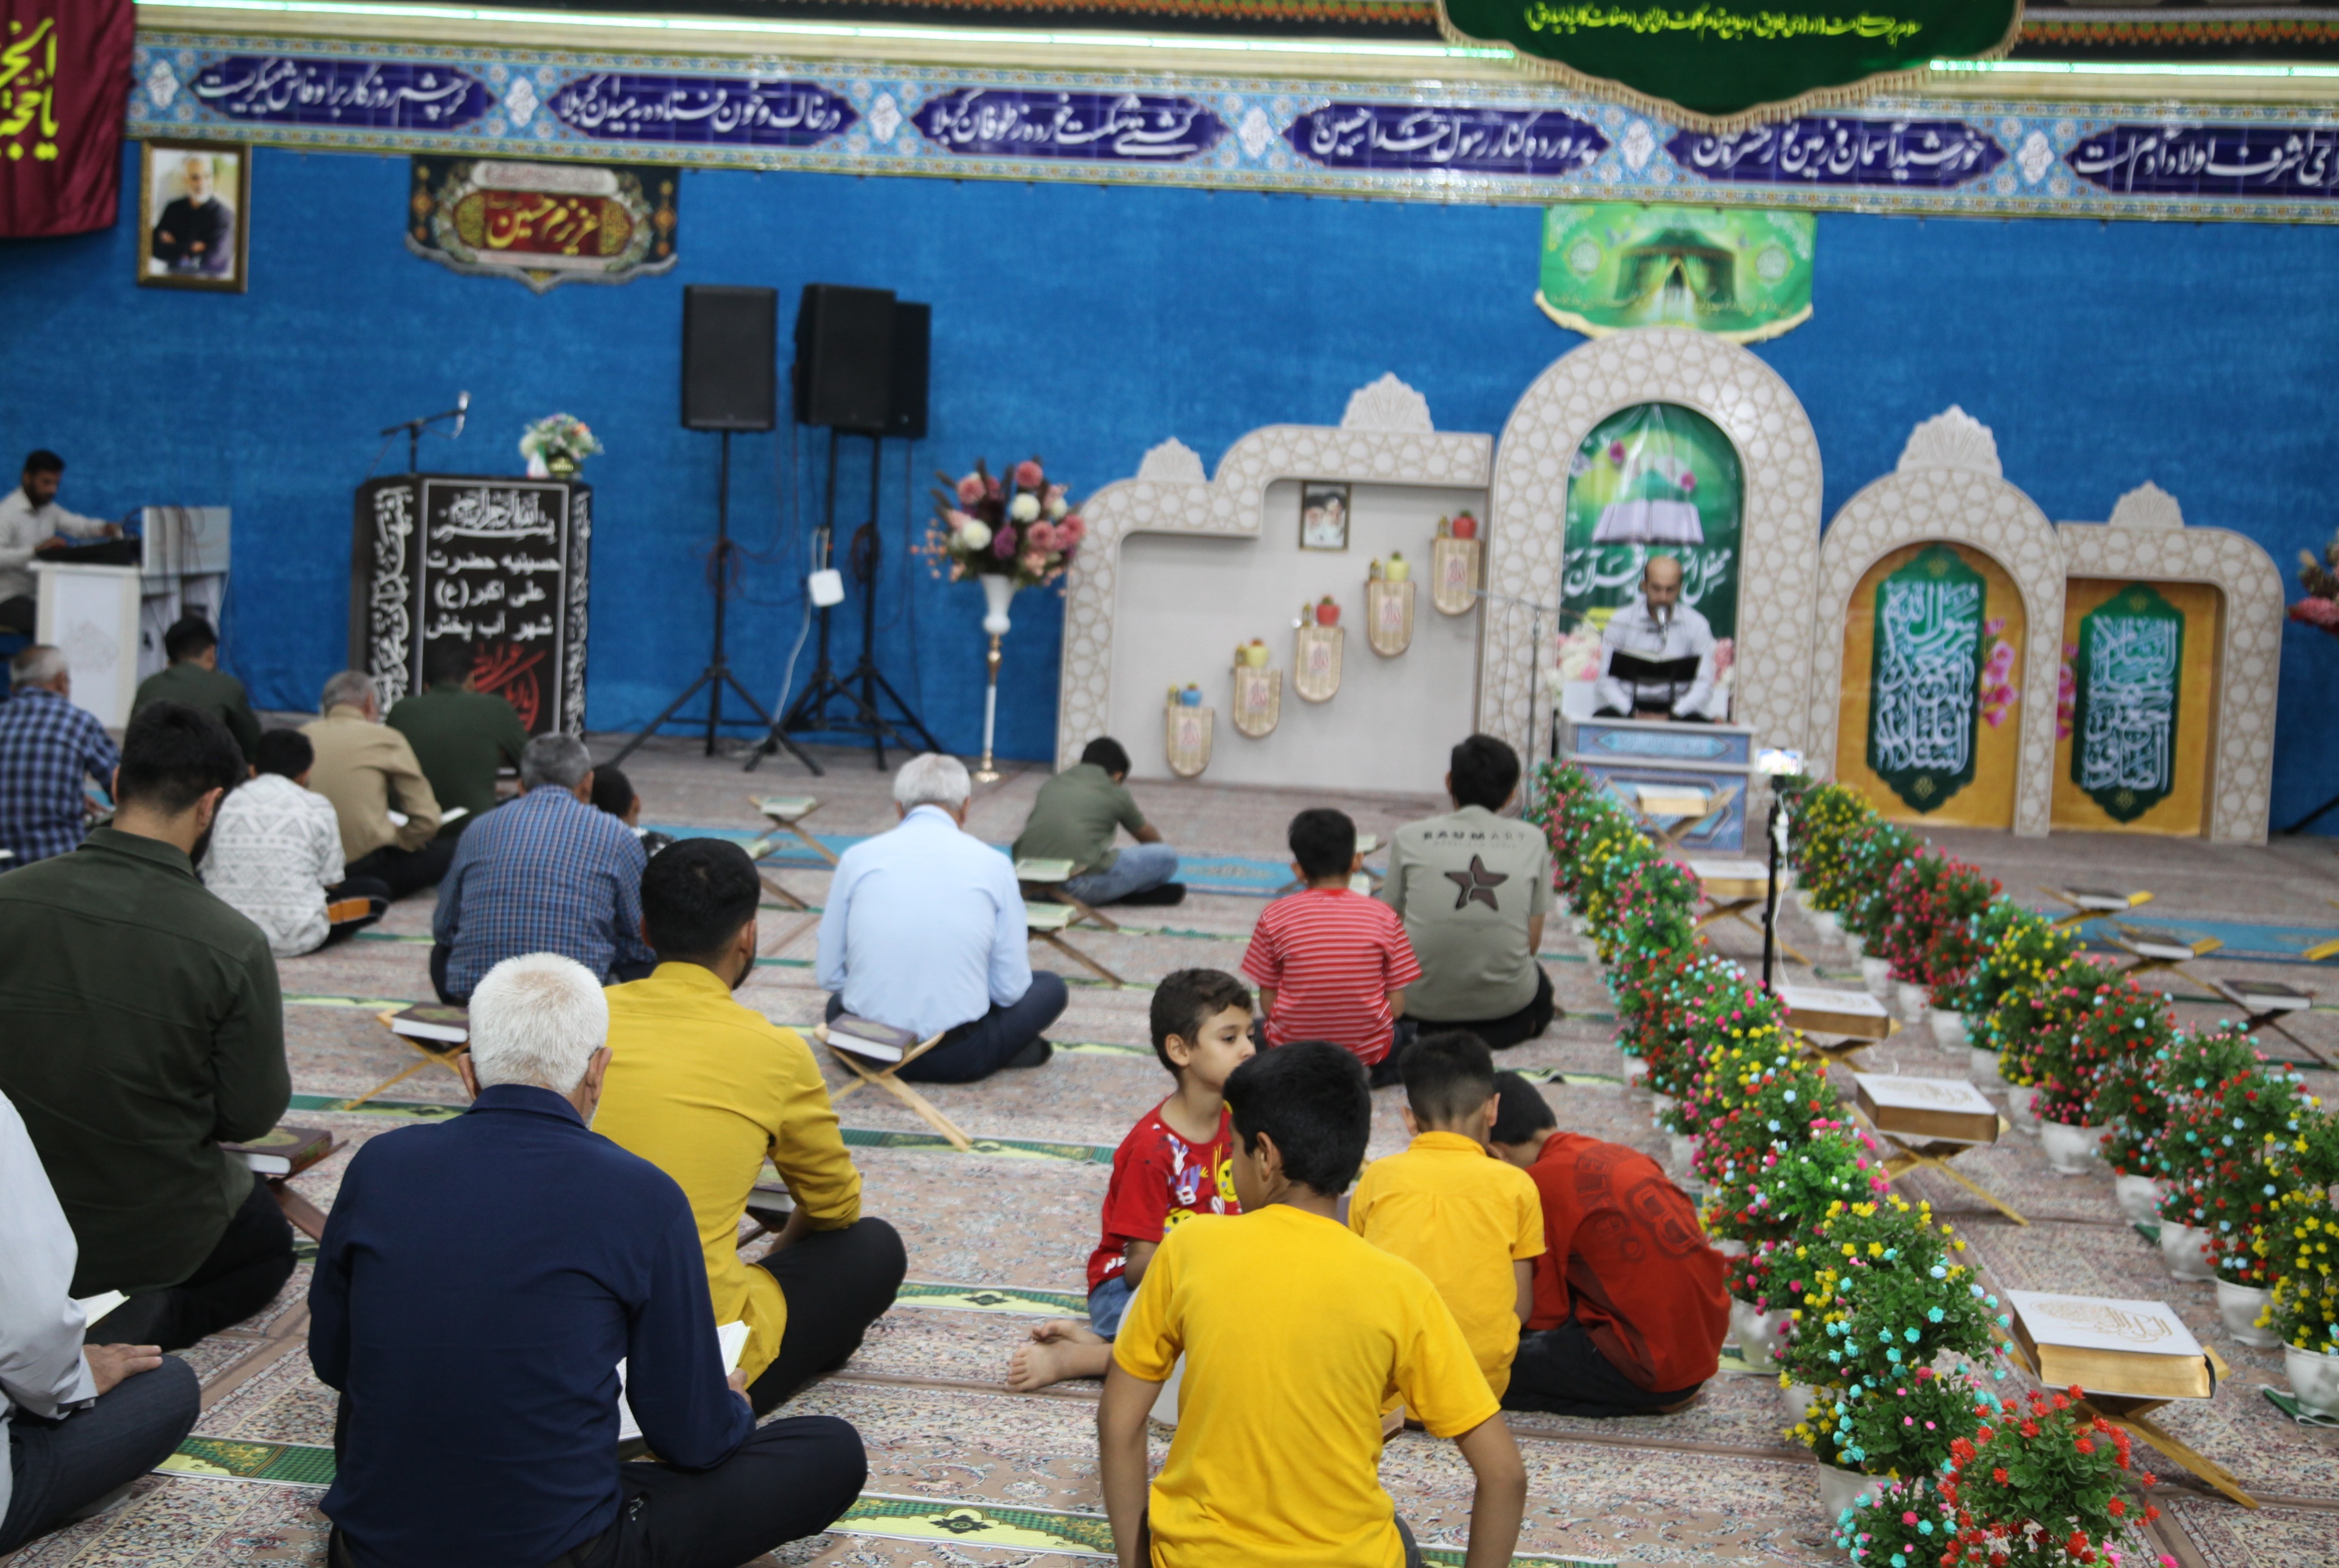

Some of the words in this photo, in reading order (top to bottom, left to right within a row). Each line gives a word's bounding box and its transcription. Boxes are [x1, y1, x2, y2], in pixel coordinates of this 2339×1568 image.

[341, 62, 398, 109] روزگار
[560, 74, 610, 124] کربلا
[713, 80, 766, 133] خون
[819, 109, 842, 130] در
[930, 89, 986, 147] کربلا
[951, 100, 1018, 143] طوفان
[1052, 92, 1142, 144] شکست
[1113, 105, 1201, 156] کشتی
[1310, 106, 1372, 156] حسین
[1370, 107, 1452, 151] خدا
[1428, 114, 1489, 162] رسول
[1489, 112, 1544, 158] کنار
[1522, 135, 1599, 164] پرورده
[1886, 130, 1985, 181] خورشید
[2074, 133, 2137, 174] است
[2162, 134, 2217, 176] اولاد
[486, 197, 558, 250] حسین
[426, 549, 498, 575] حضرت
[500, 551, 561, 576] حسینیه
[470, 579, 505, 607] اکبر
[508, 579, 546, 608] علی
[425, 612, 473, 642] پخش
[510, 613, 554, 642] شهر
